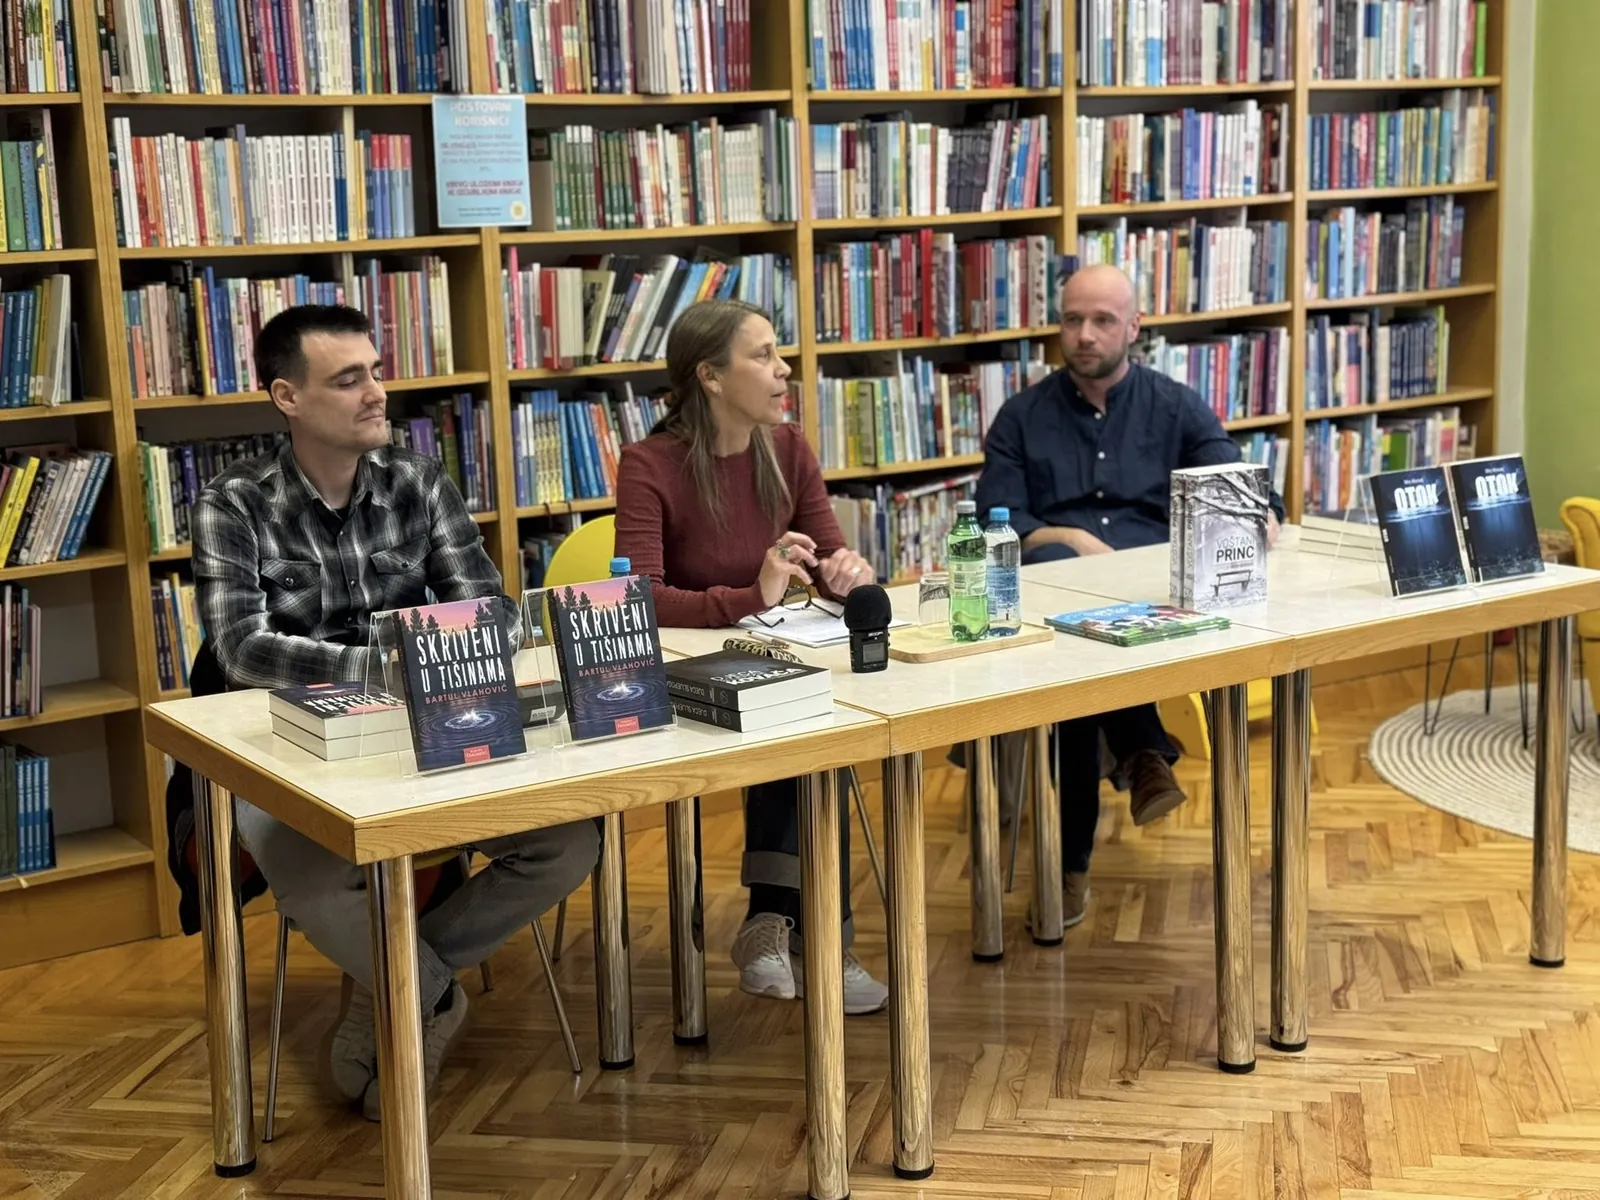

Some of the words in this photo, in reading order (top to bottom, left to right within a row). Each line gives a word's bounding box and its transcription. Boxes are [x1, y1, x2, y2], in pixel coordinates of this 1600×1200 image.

[1394, 484, 1438, 510] OTOK
[1475, 473, 1519, 497] OTOK
[1216, 535, 1255, 549] VOŠTANI
[1216, 545, 1255, 563] PRINC
[570, 602, 649, 640] SKRIVENI
[418, 626, 501, 664] SKRIVENI
[574, 642, 584, 667] U
[590, 631, 655, 664] TIŠINAMA
[420, 668, 431, 694] U
[440, 658, 506, 688] TIŠINAMA
[578, 666, 612, 678] BARTUL
[612, 657, 656, 674] VLAHOVIĆ
[425, 692, 459, 706] BARTUL
[460, 683, 508, 700] VLAHOVIĆ
